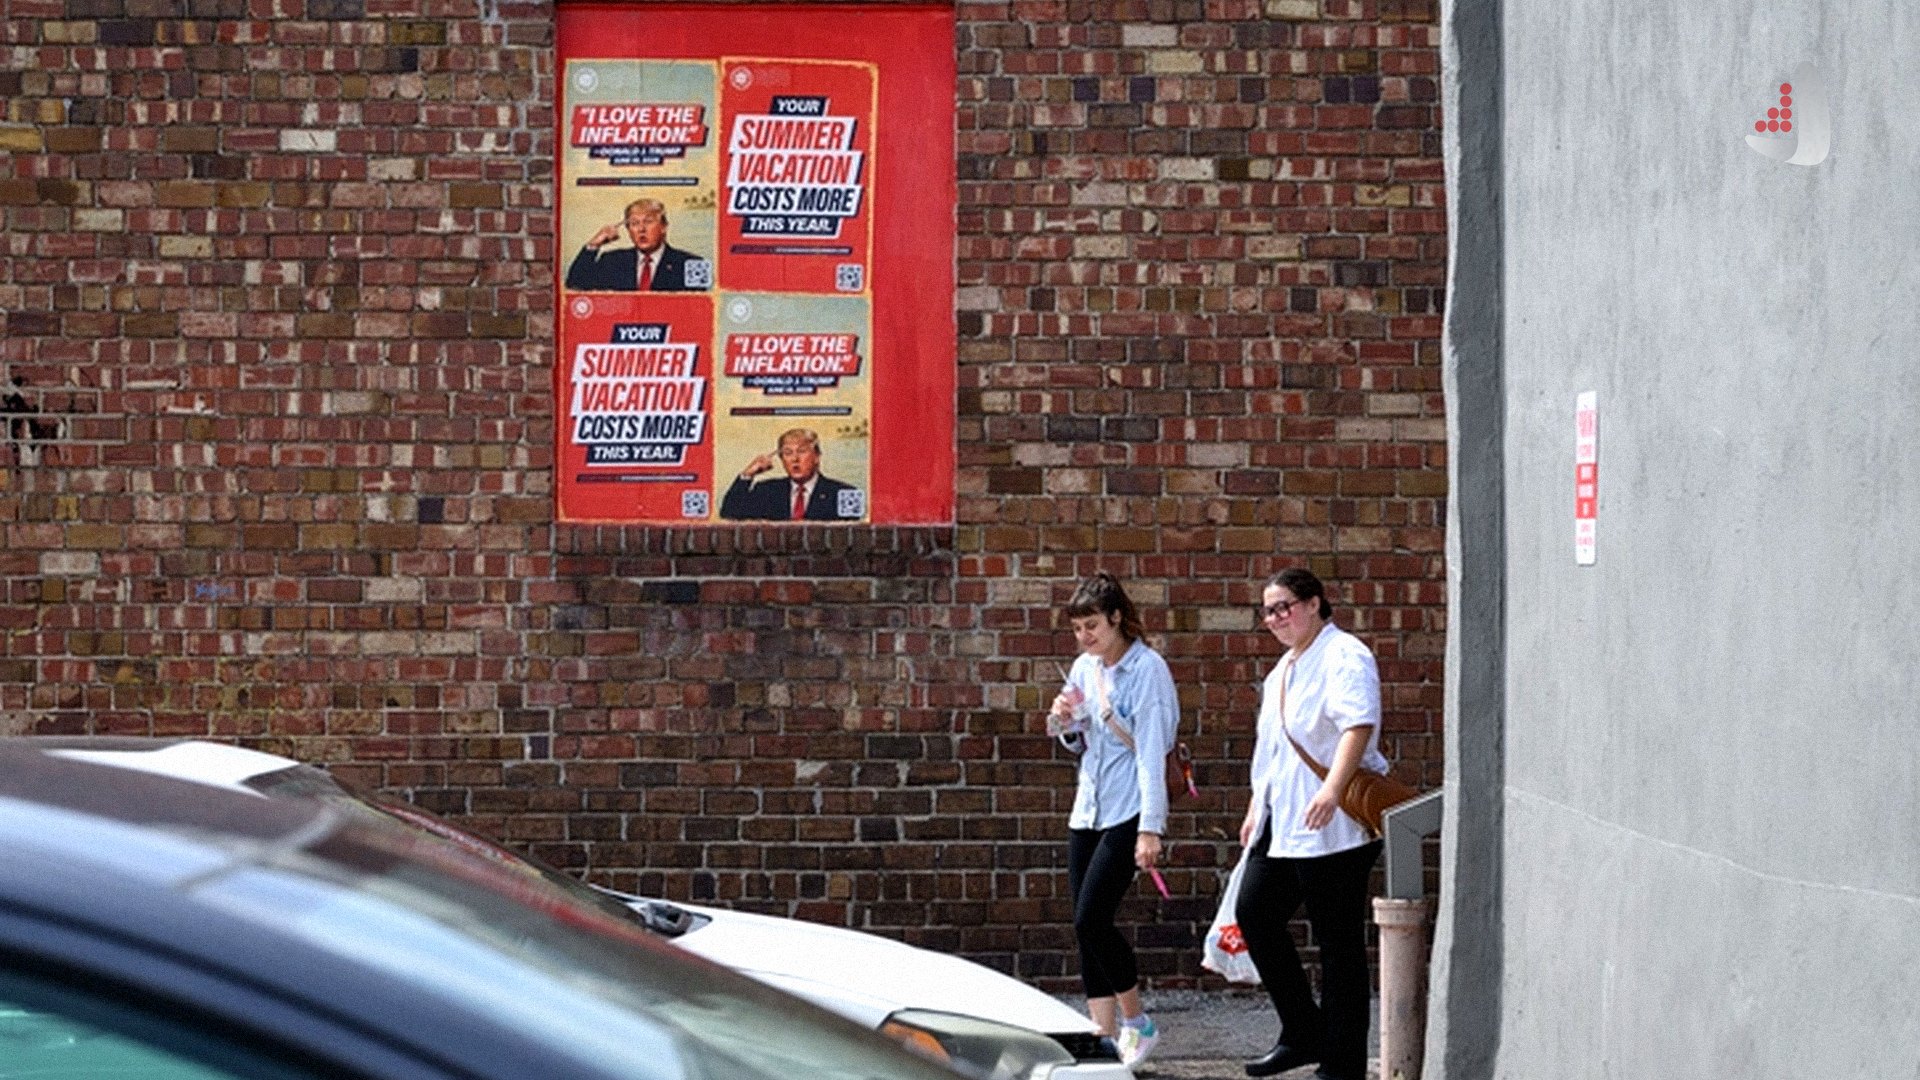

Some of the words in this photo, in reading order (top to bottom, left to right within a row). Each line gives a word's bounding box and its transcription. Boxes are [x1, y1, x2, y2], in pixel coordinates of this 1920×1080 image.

[598, 107, 651, 124] LOVE
[655, 108, 695, 124] THE
[776, 98, 822, 113] YOUR
[738, 119, 846, 150] SUMMER
[738, 152, 853, 184] VACATION
[733, 186, 796, 211] COSTS
[796, 187, 856, 212] MORE
[749, 217, 786, 231] THIS
[617, 327, 663, 341] YOUR
[751, 336, 805, 353] LOVE
[809, 337, 849, 353] THE
[581, 348, 689, 378] SUMMER
[581, 381, 696, 412] VACATION
[577, 415, 640, 440] COSTS
[640, 415, 699, 440] MORE
[594, 445, 630, 459] THIS
